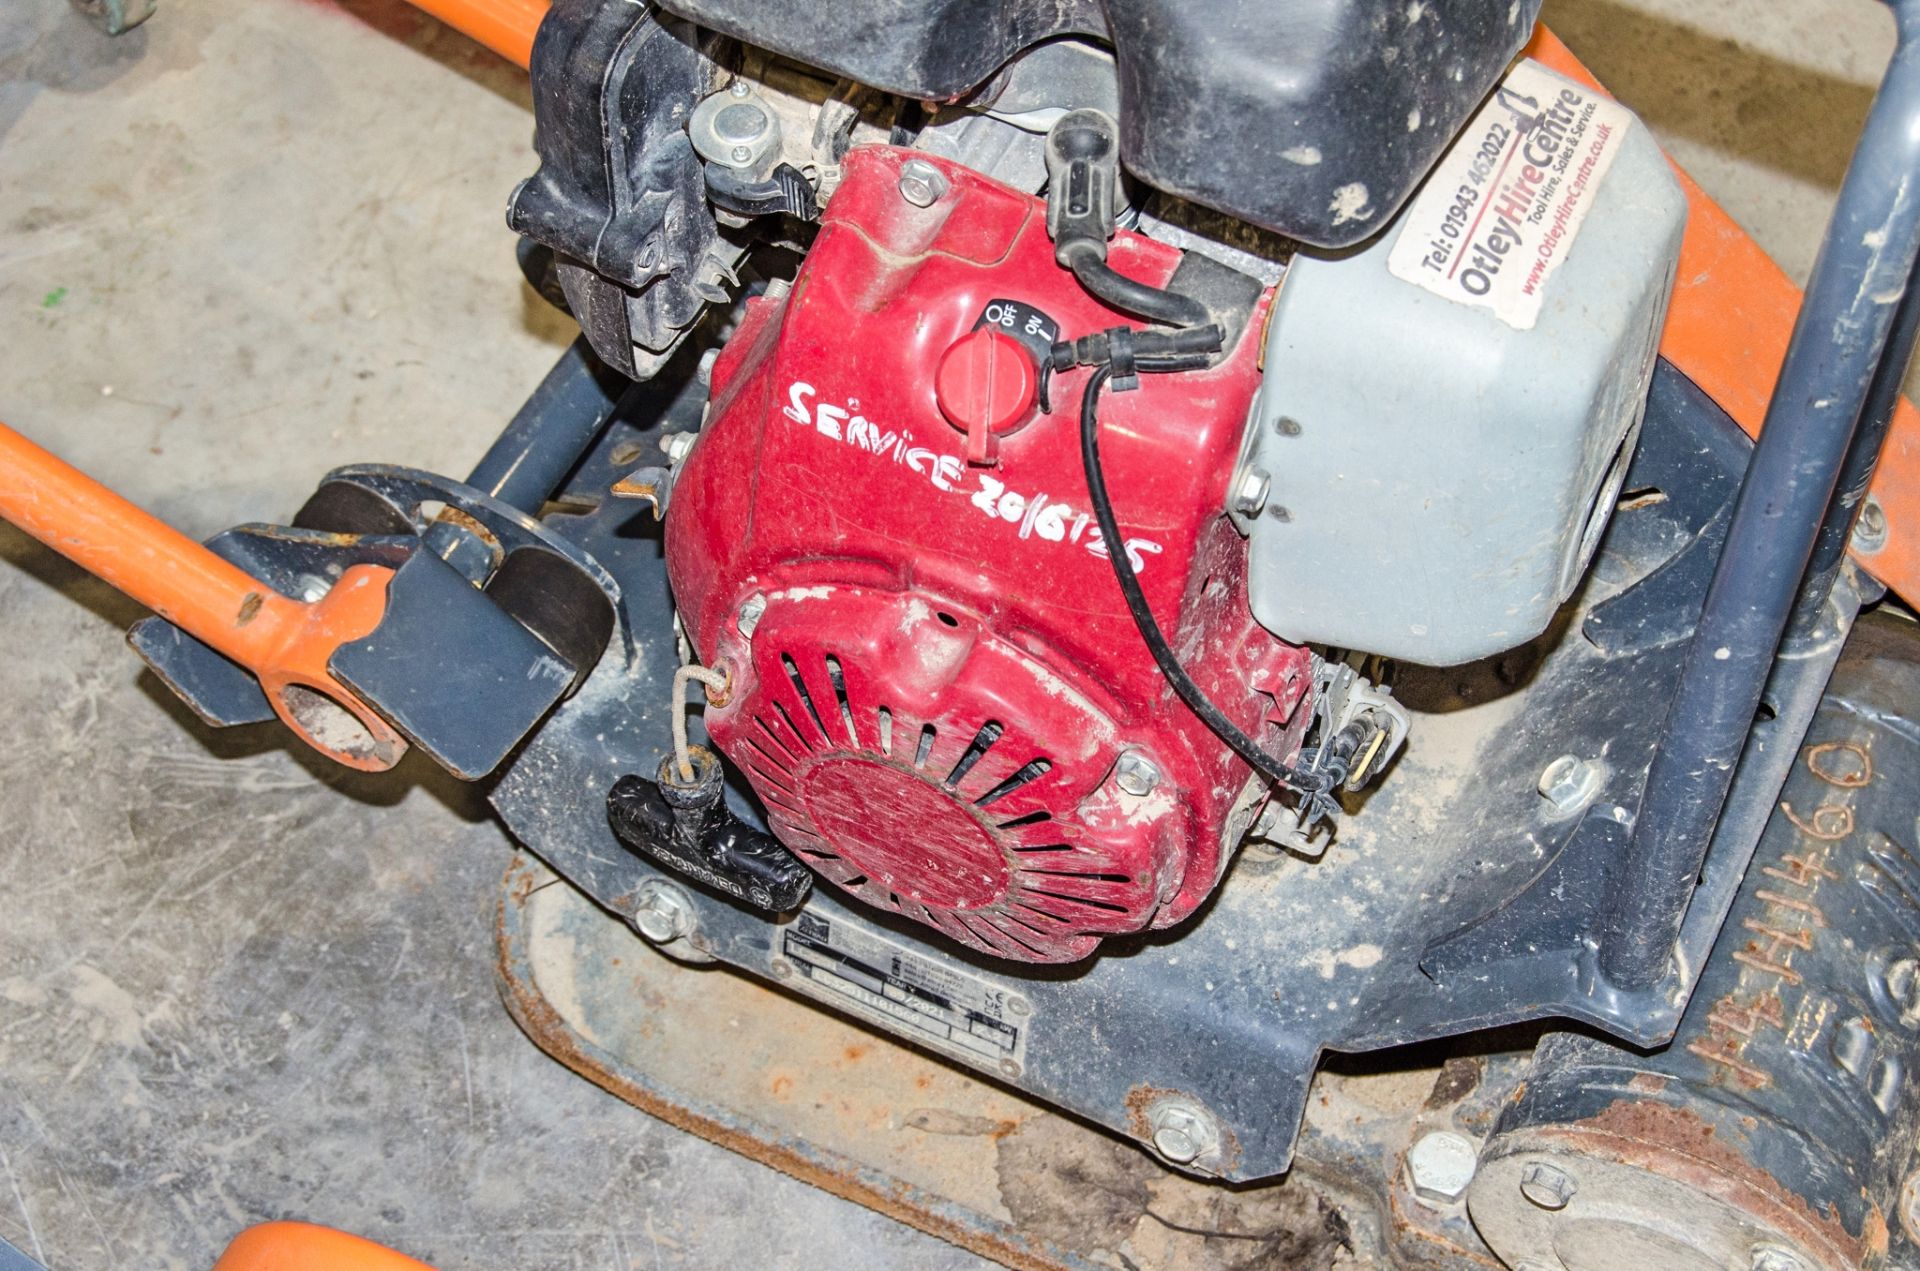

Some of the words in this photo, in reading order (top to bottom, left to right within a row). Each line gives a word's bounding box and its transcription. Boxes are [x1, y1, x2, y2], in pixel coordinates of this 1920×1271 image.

[1566, 136, 1578, 147] &
[1550, 144, 1575, 174] Sales
[1421, 240, 1453, 273] Tel:
[1440, 184, 1479, 242] 01943
[1467, 122, 1511, 187] 462022
[1538, 172, 1563, 203] Hire,
[1522, 122, 1611, 296] www.OtleyHireCentre.co.uk
[1526, 204, 1548, 226] Tool
[1001, 304, 1018, 327] OFF
[1024, 314, 1043, 335] ON
[885, 975, 908, 989] YEAR
